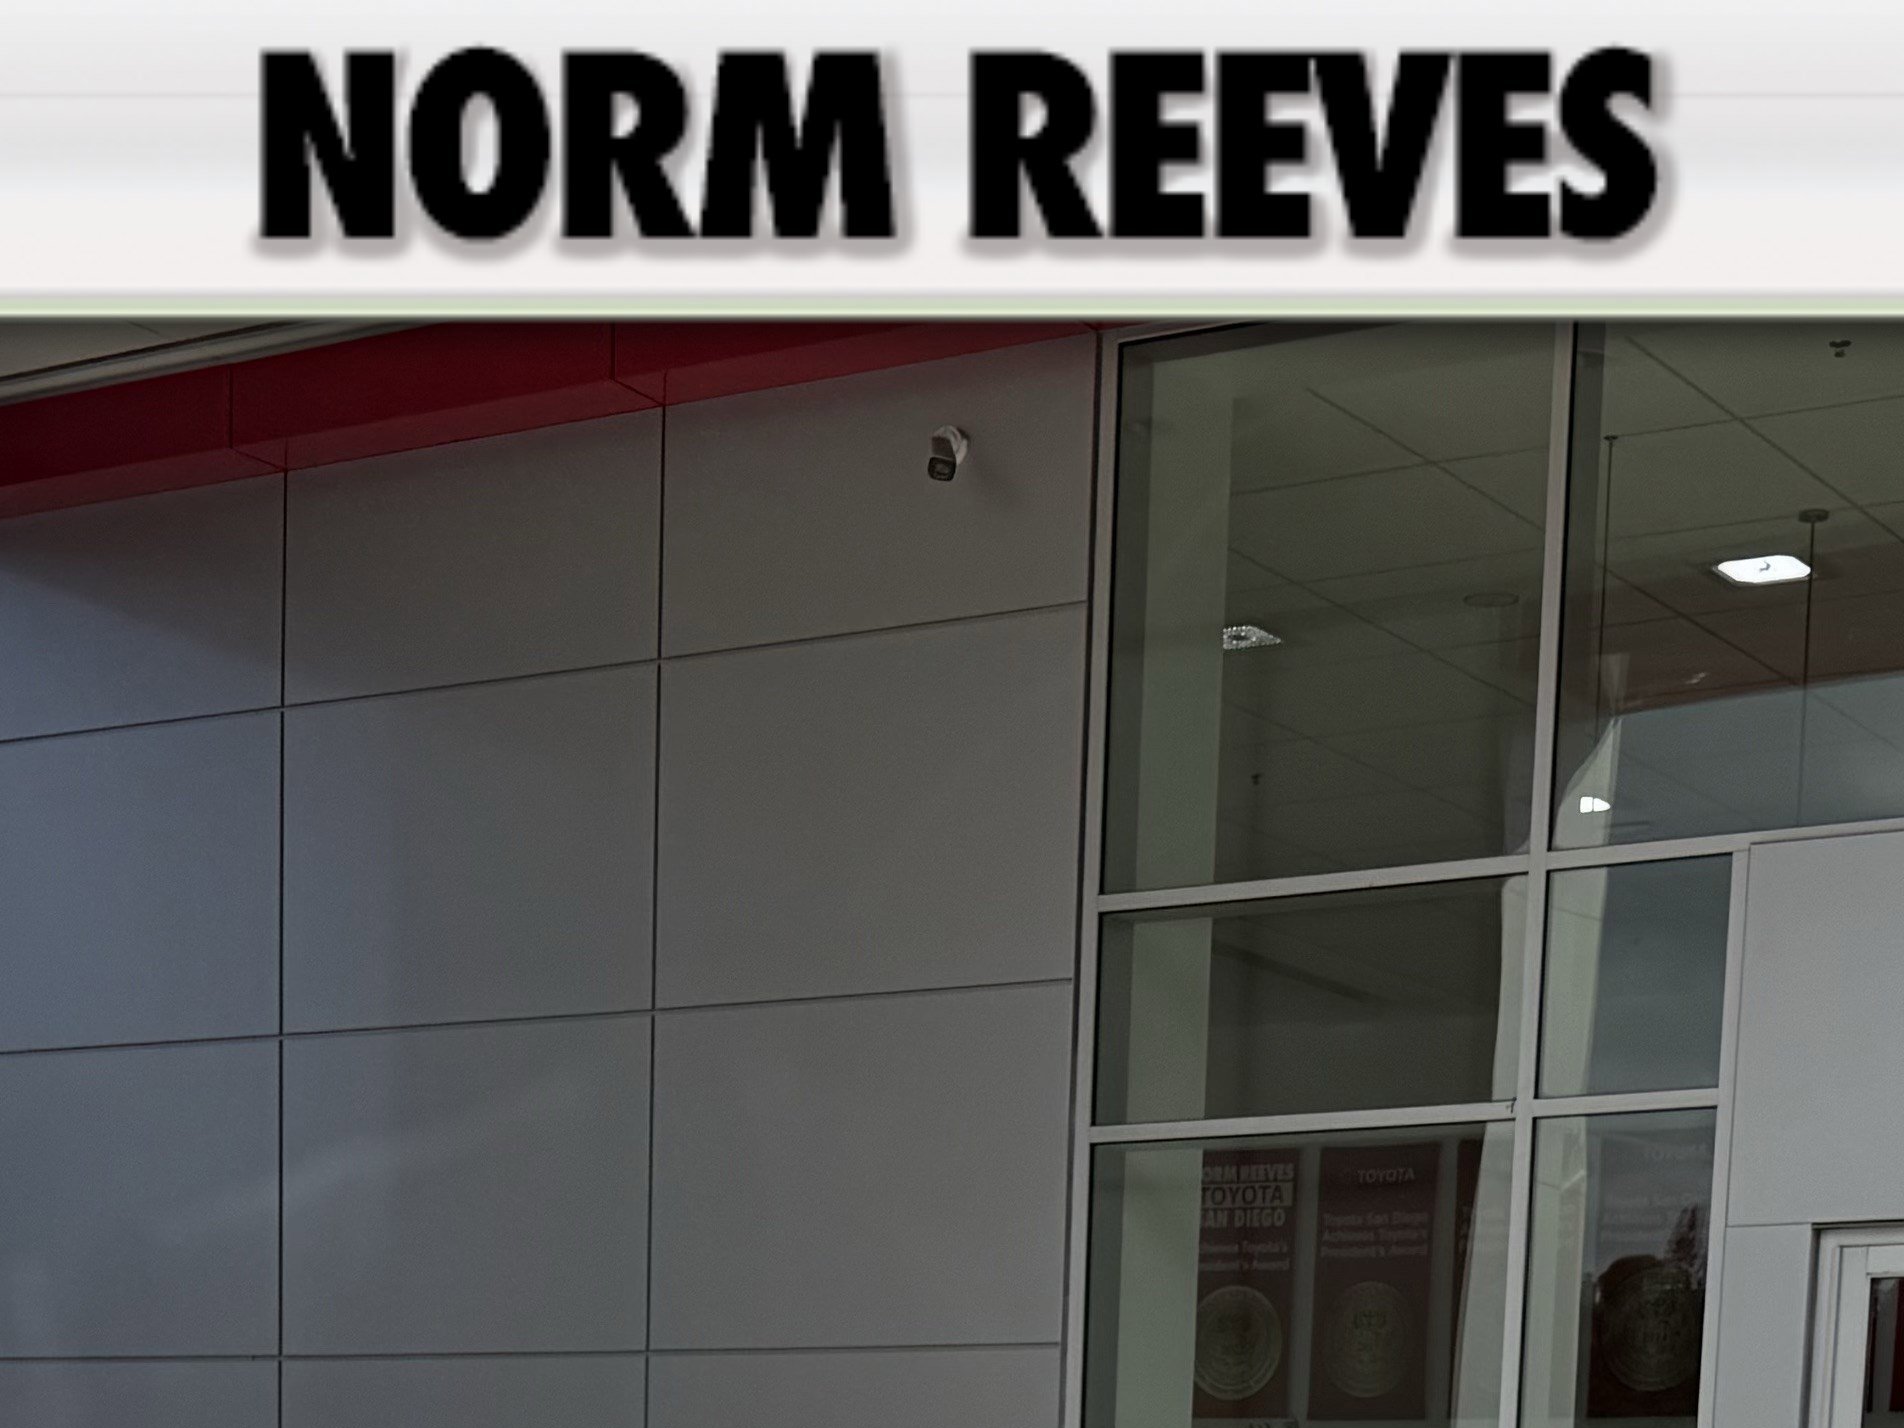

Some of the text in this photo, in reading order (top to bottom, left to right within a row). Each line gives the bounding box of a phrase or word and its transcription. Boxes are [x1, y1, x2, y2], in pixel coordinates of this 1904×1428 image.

[1202, 1165, 1237, 1182] ORM
[1357, 1168, 1415, 1184] TOYOTA
[1202, 1185, 1284, 1206] TOYOTA
[1202, 1209, 1285, 1228] AN DIEGO
